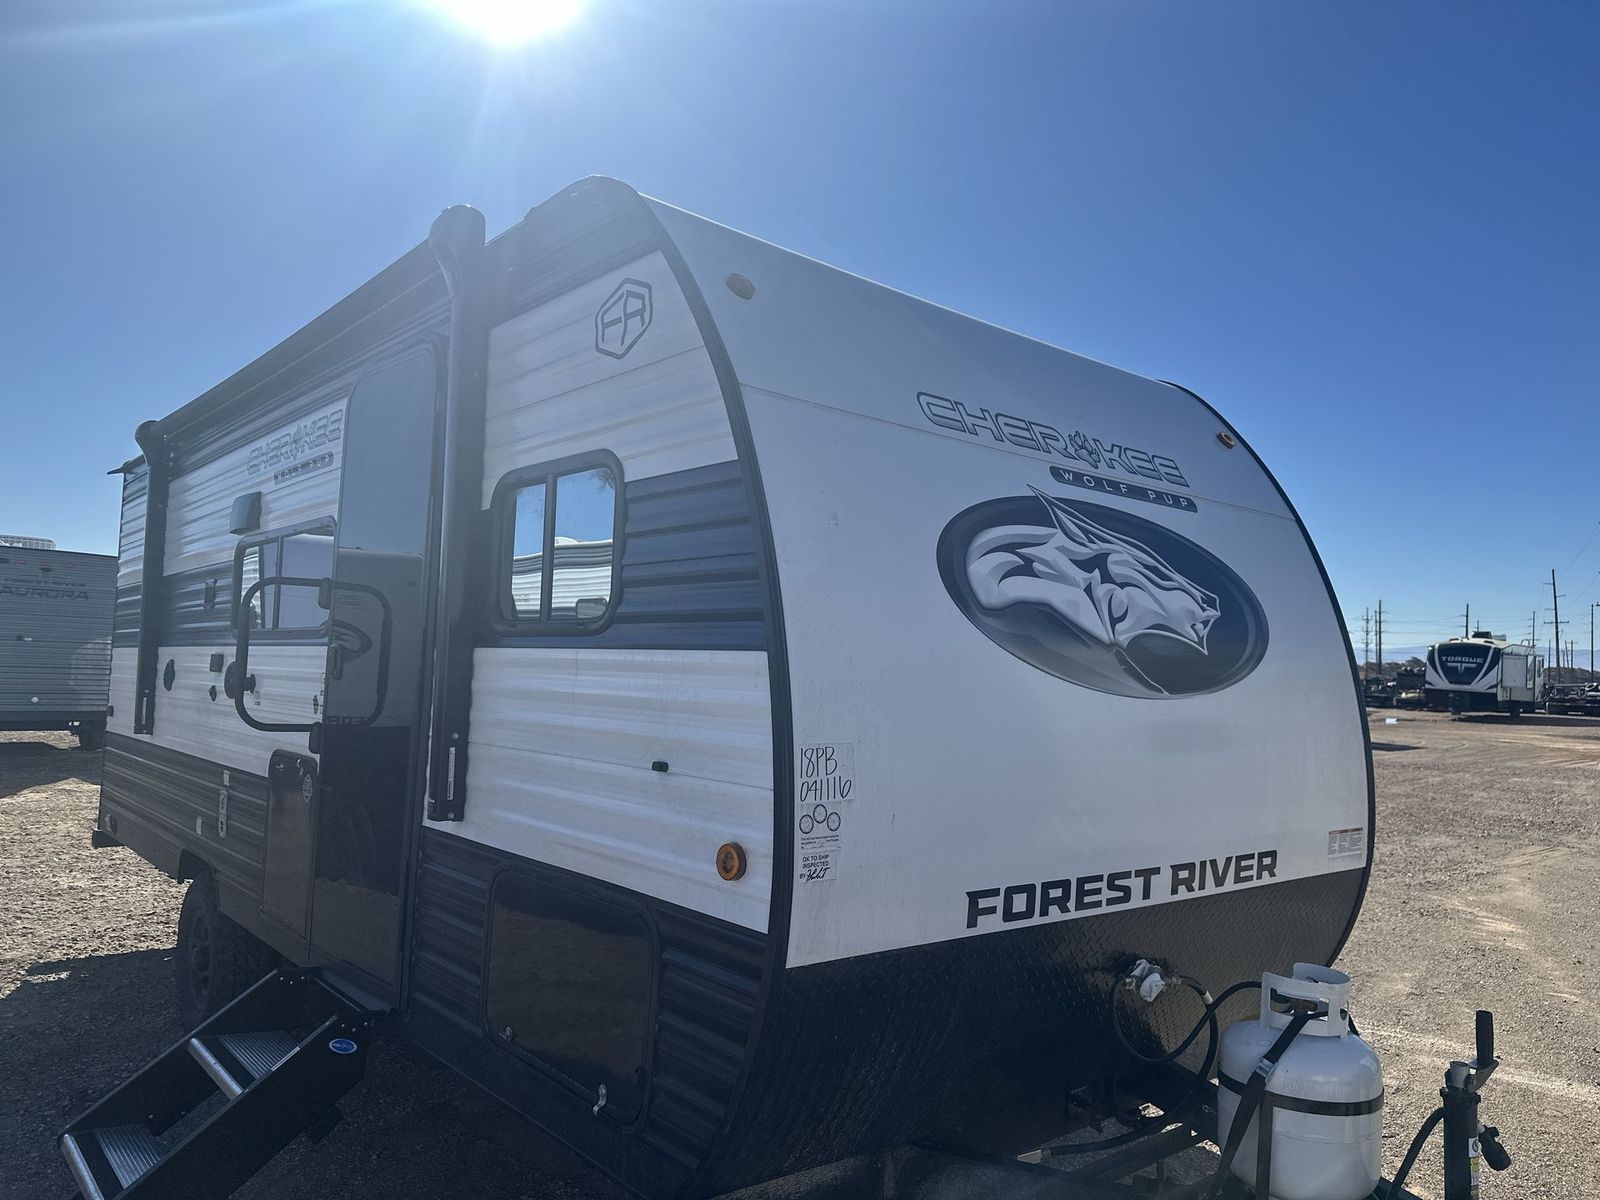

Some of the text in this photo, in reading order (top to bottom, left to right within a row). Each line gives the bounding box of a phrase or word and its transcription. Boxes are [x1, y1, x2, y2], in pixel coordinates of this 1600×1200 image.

[1060, 470, 1188, 507] WOLF PUP
[1440, 656, 1484, 664] TORQUE
[800, 746, 838, 779] 18PB
[965, 849, 1278, 929] FOREST RIVER
